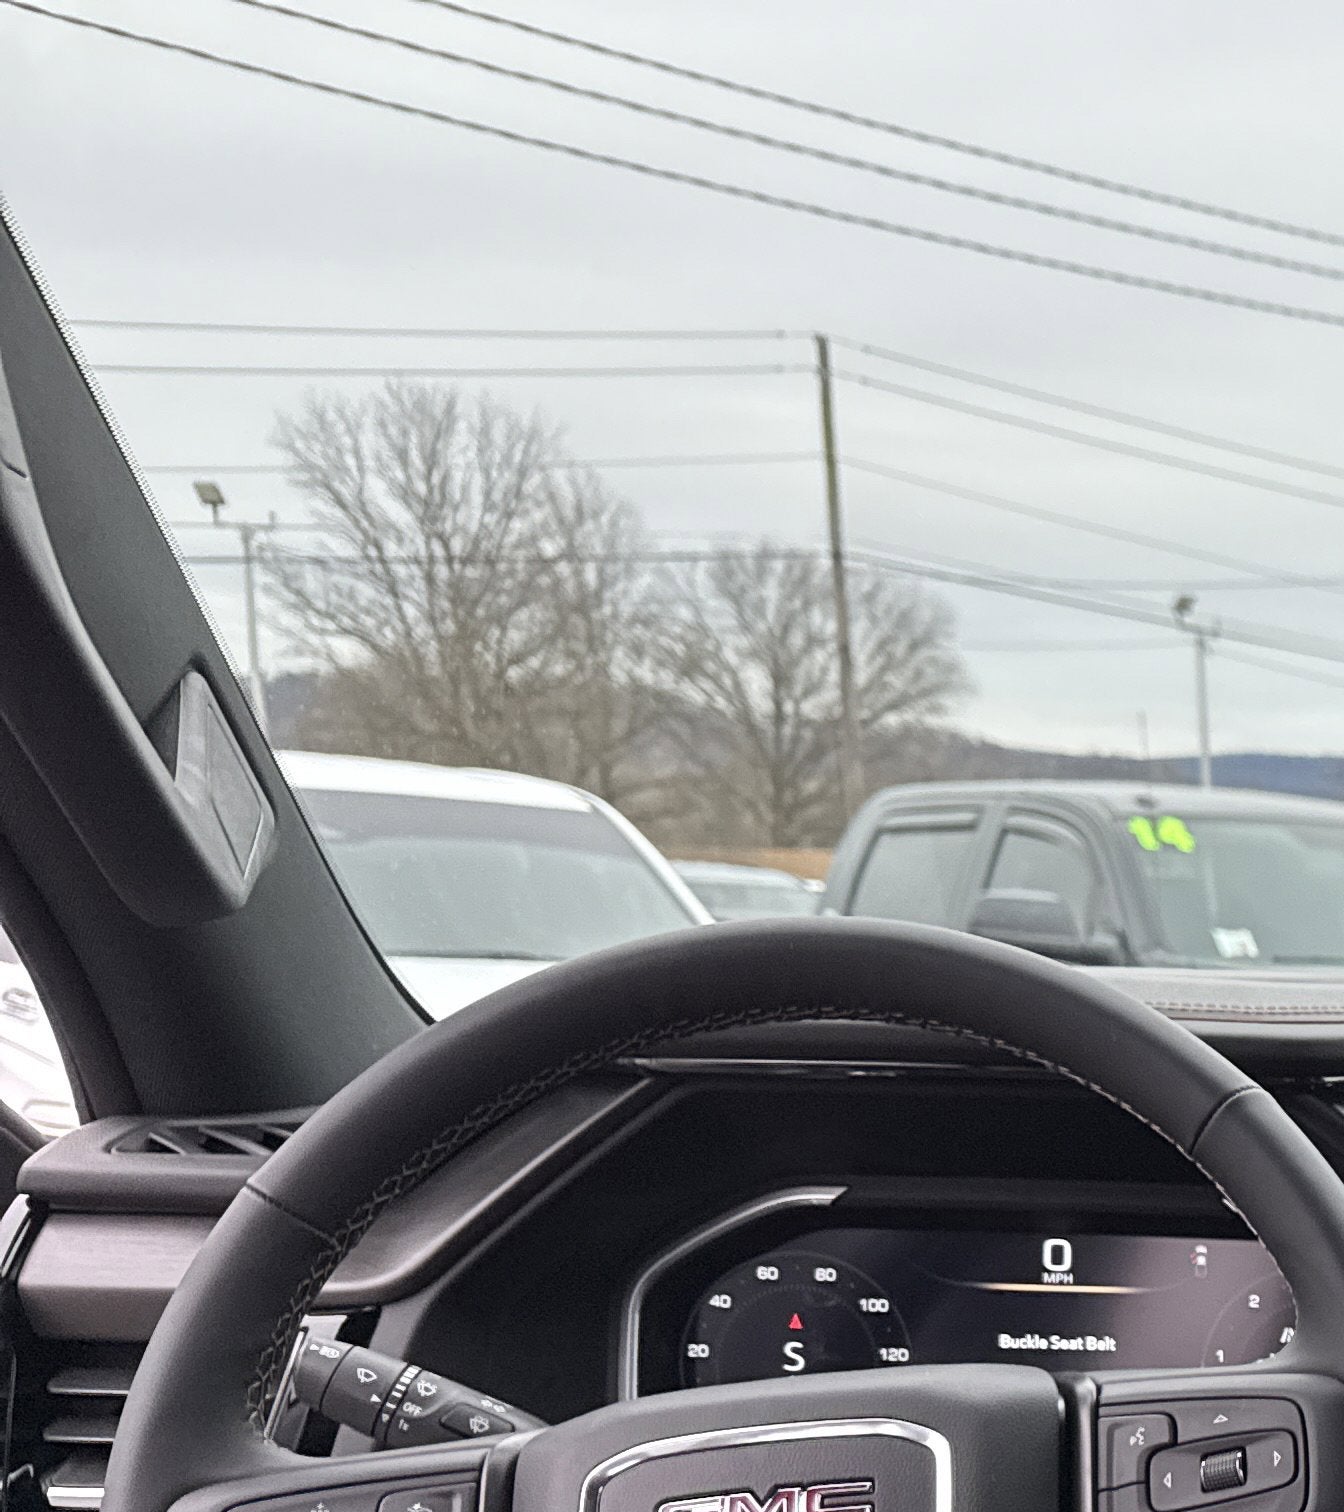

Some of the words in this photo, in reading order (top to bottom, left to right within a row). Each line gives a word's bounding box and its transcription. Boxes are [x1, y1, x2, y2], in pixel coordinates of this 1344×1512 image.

[1042, 1239, 1071, 1271] 0
[756, 1266, 778, 1281] 60
[1042, 1272, 1073, 1284] MPH
[709, 1294, 732, 1308] 40
[858, 1298, 889, 1313] 100
[1248, 1294, 1260, 1308] 2
[998, 1333, 1048, 1349] Buckle
[1049, 1335, 1084, 1350] Seat
[1085, 1336, 1116, 1351] Belt
[687, 1344, 709, 1358] 20
[783, 1342, 805, 1372] S
[879, 1348, 909, 1362] 120
[1216, 1349, 1224, 1362] 1
[403, 1402, 422, 1416] OFF
